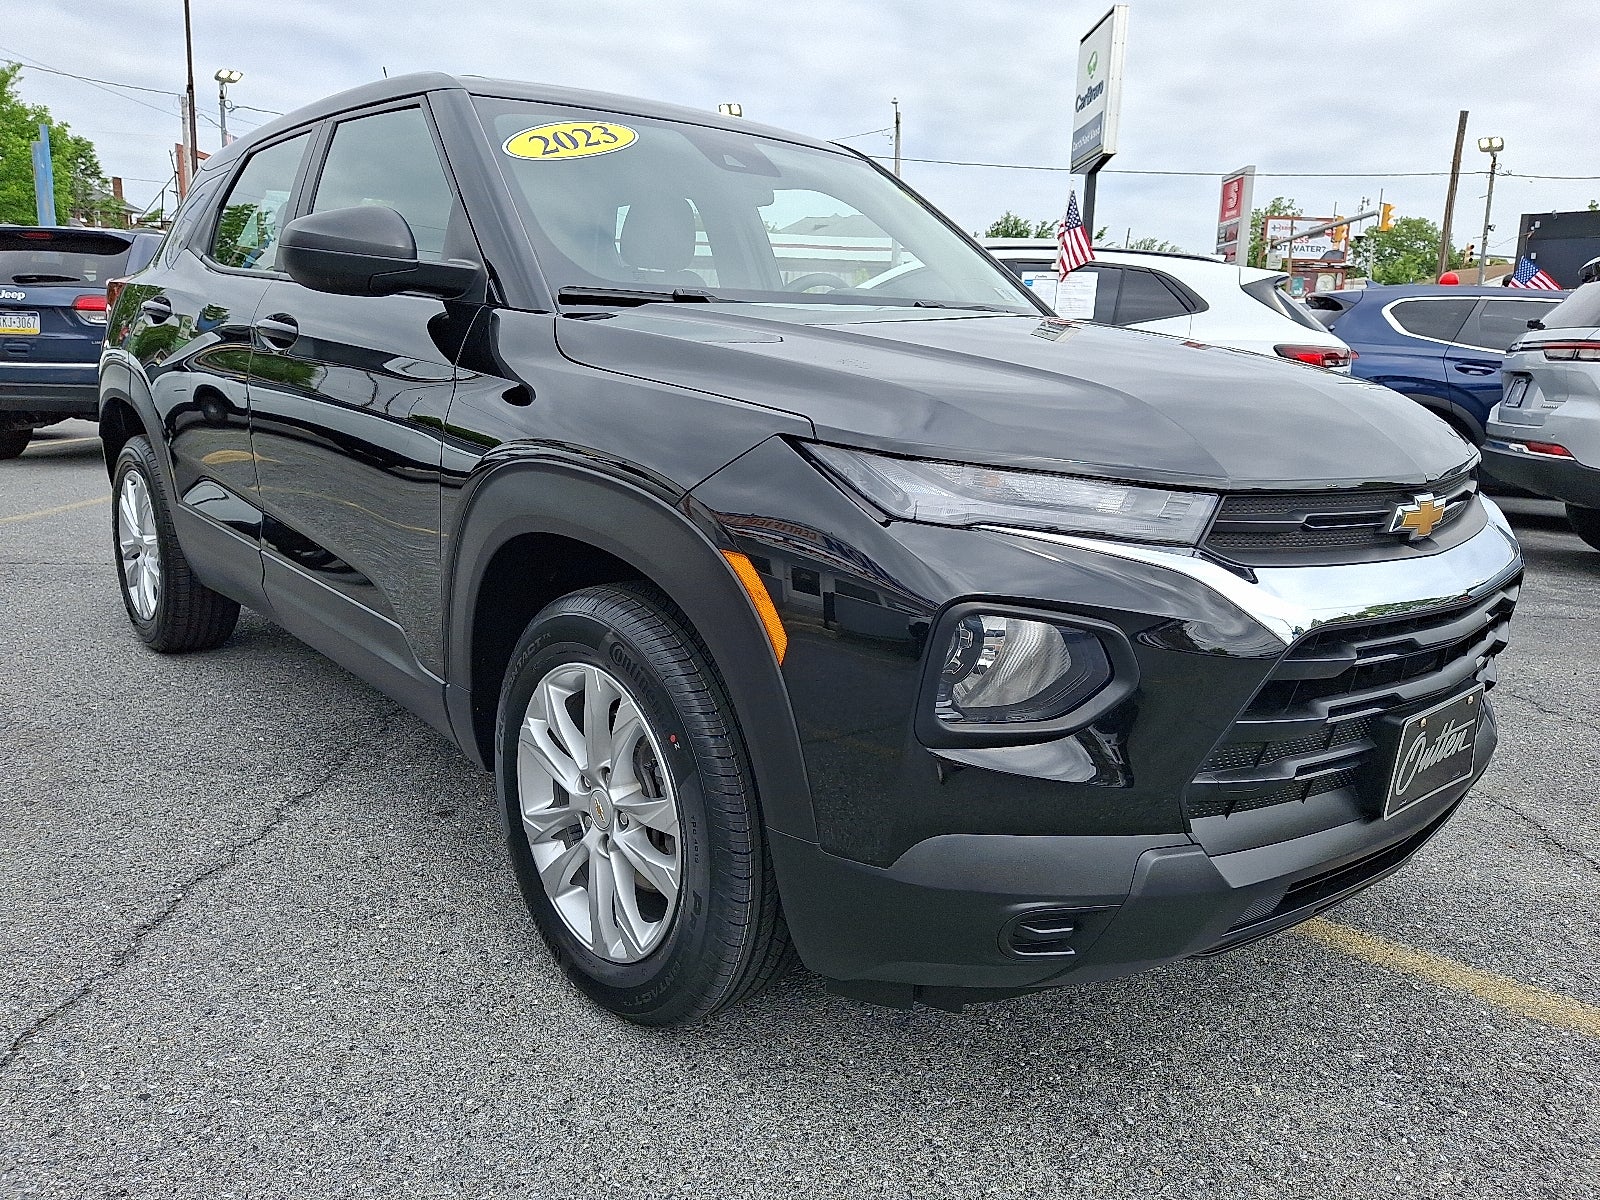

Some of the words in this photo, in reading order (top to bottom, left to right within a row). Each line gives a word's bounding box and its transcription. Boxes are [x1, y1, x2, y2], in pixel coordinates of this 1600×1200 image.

[1075, 80, 1104, 113] CarBravo
[528, 125, 619, 156] 2023
[0, 290, 26, 301] Jeep
[1396, 718, 1476, 796] Outten
